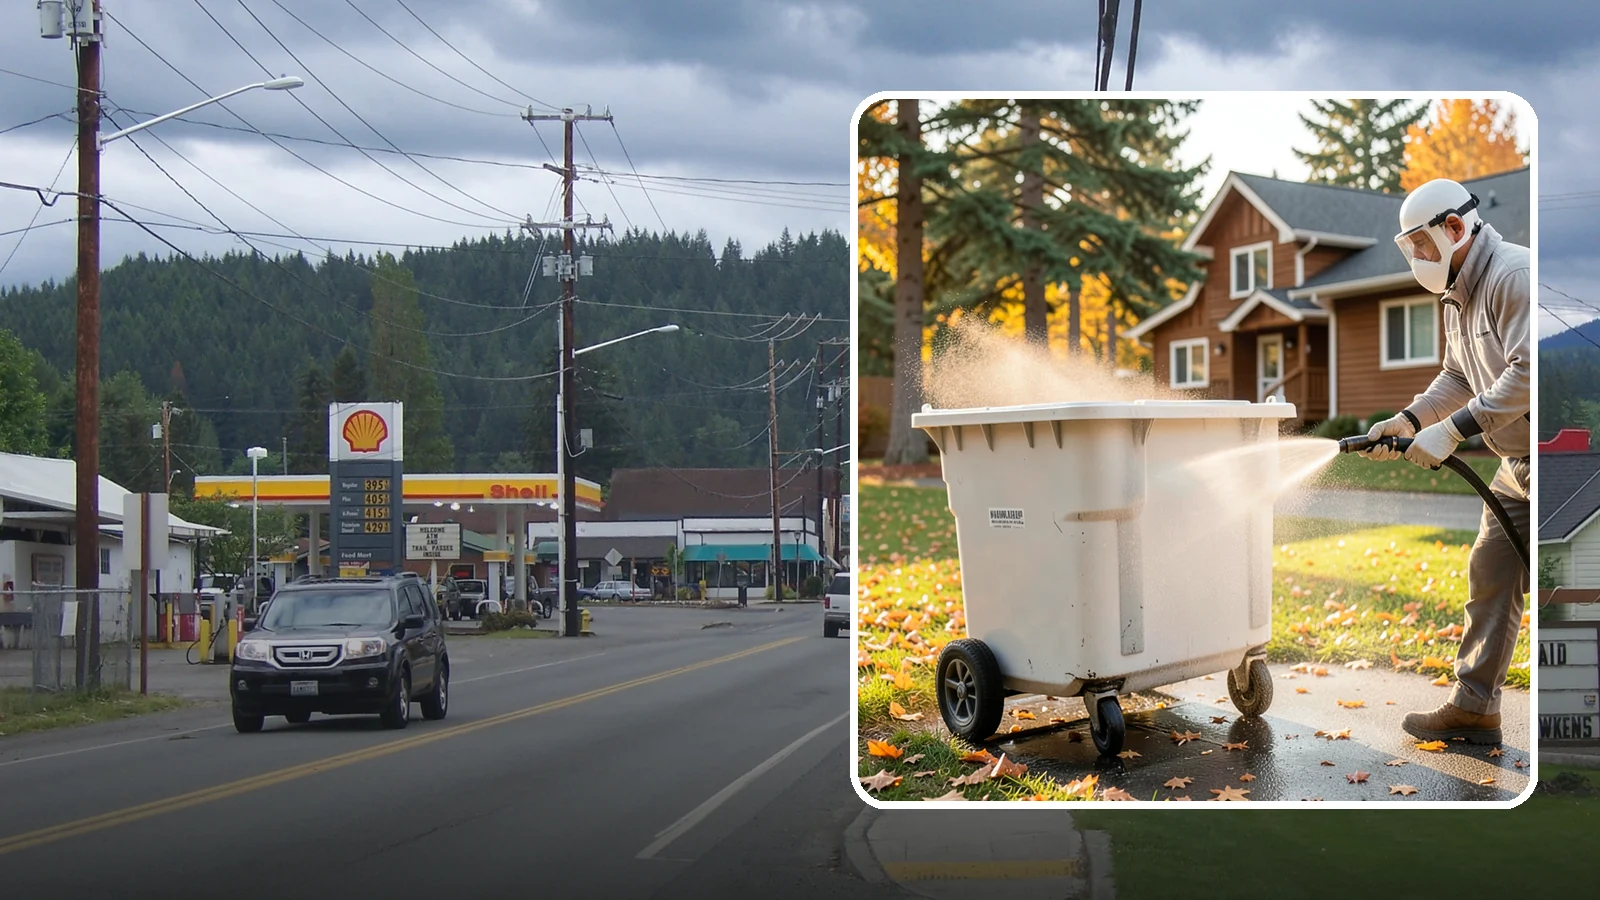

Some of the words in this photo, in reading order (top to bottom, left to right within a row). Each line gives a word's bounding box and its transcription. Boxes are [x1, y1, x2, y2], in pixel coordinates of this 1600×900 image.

[366, 480, 383, 490] 395
[490, 484, 547, 499] Shell
[366, 494, 383, 504] 405
[366, 508, 383, 518] 415
[366, 522, 383, 532] 429
[1538, 642, 1566, 666] AID
